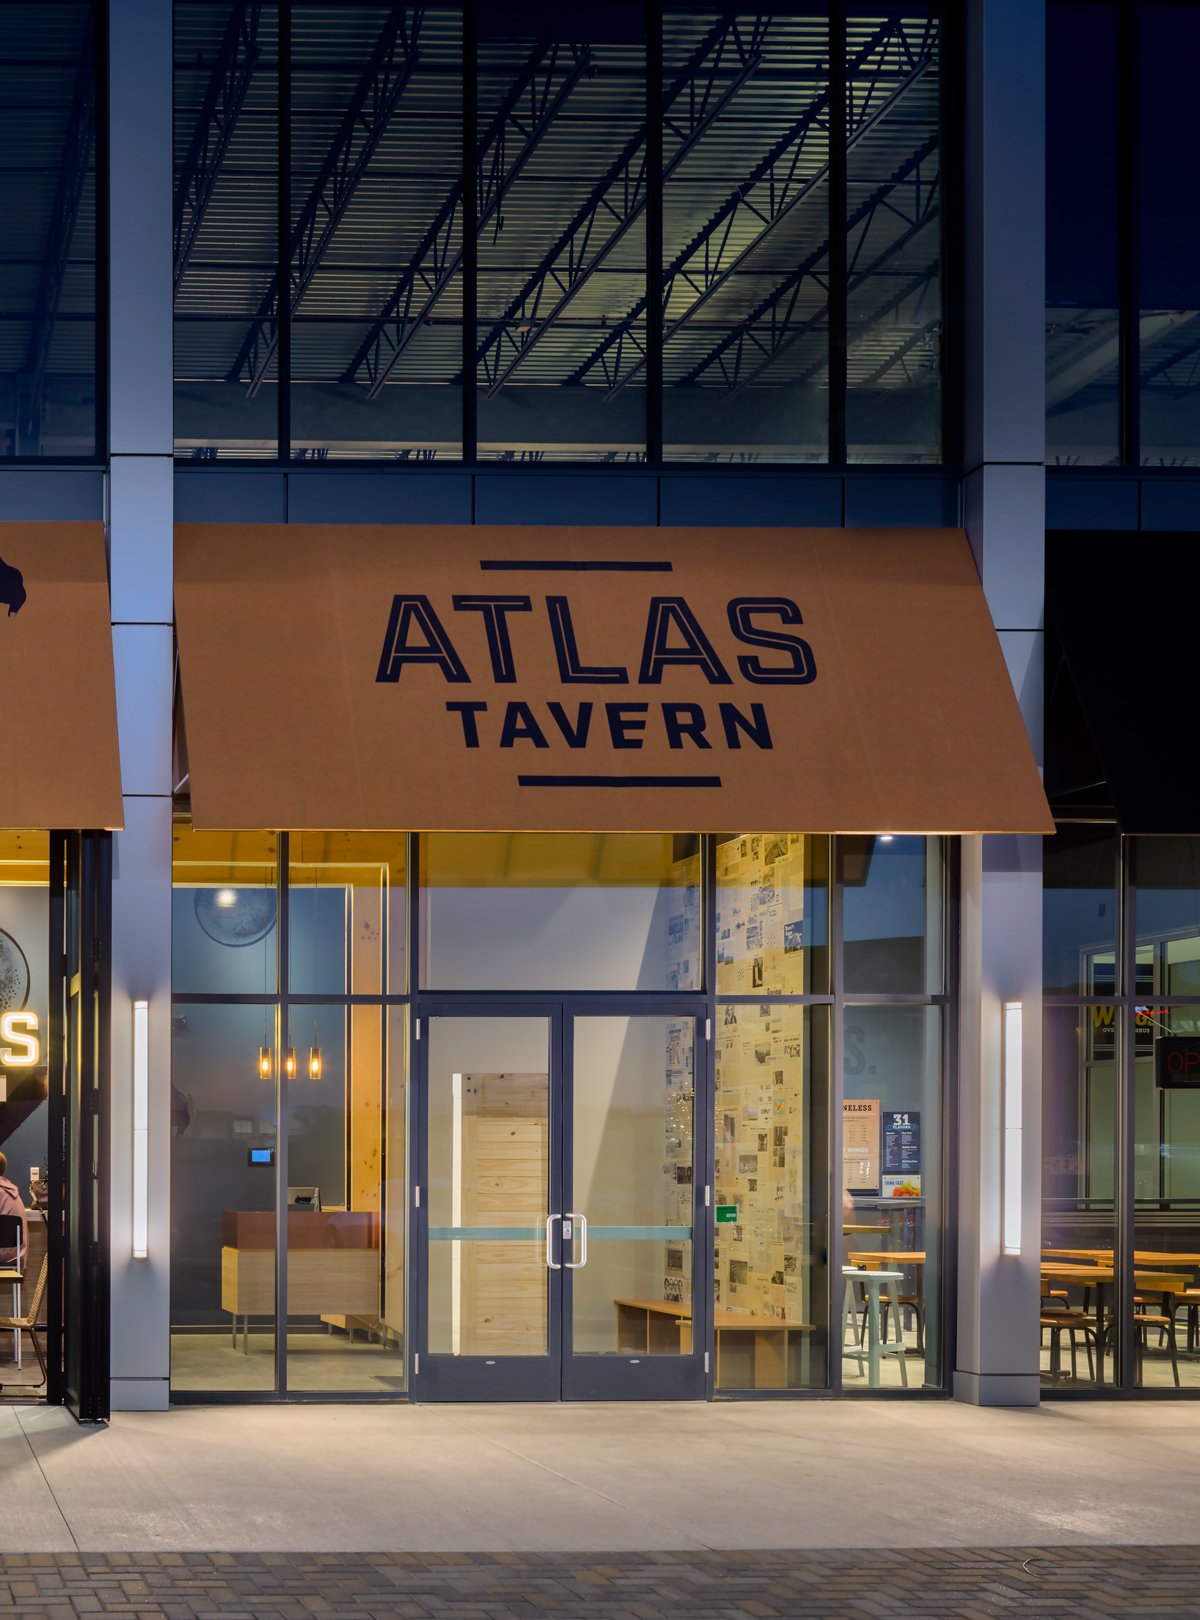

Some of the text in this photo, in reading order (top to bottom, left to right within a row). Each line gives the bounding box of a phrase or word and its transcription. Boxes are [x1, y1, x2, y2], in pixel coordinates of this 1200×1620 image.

[375, 594, 818, 686] ATLAS
[445, 701, 774, 750] TAVERN
[893, 1113, 911, 1125] 31
